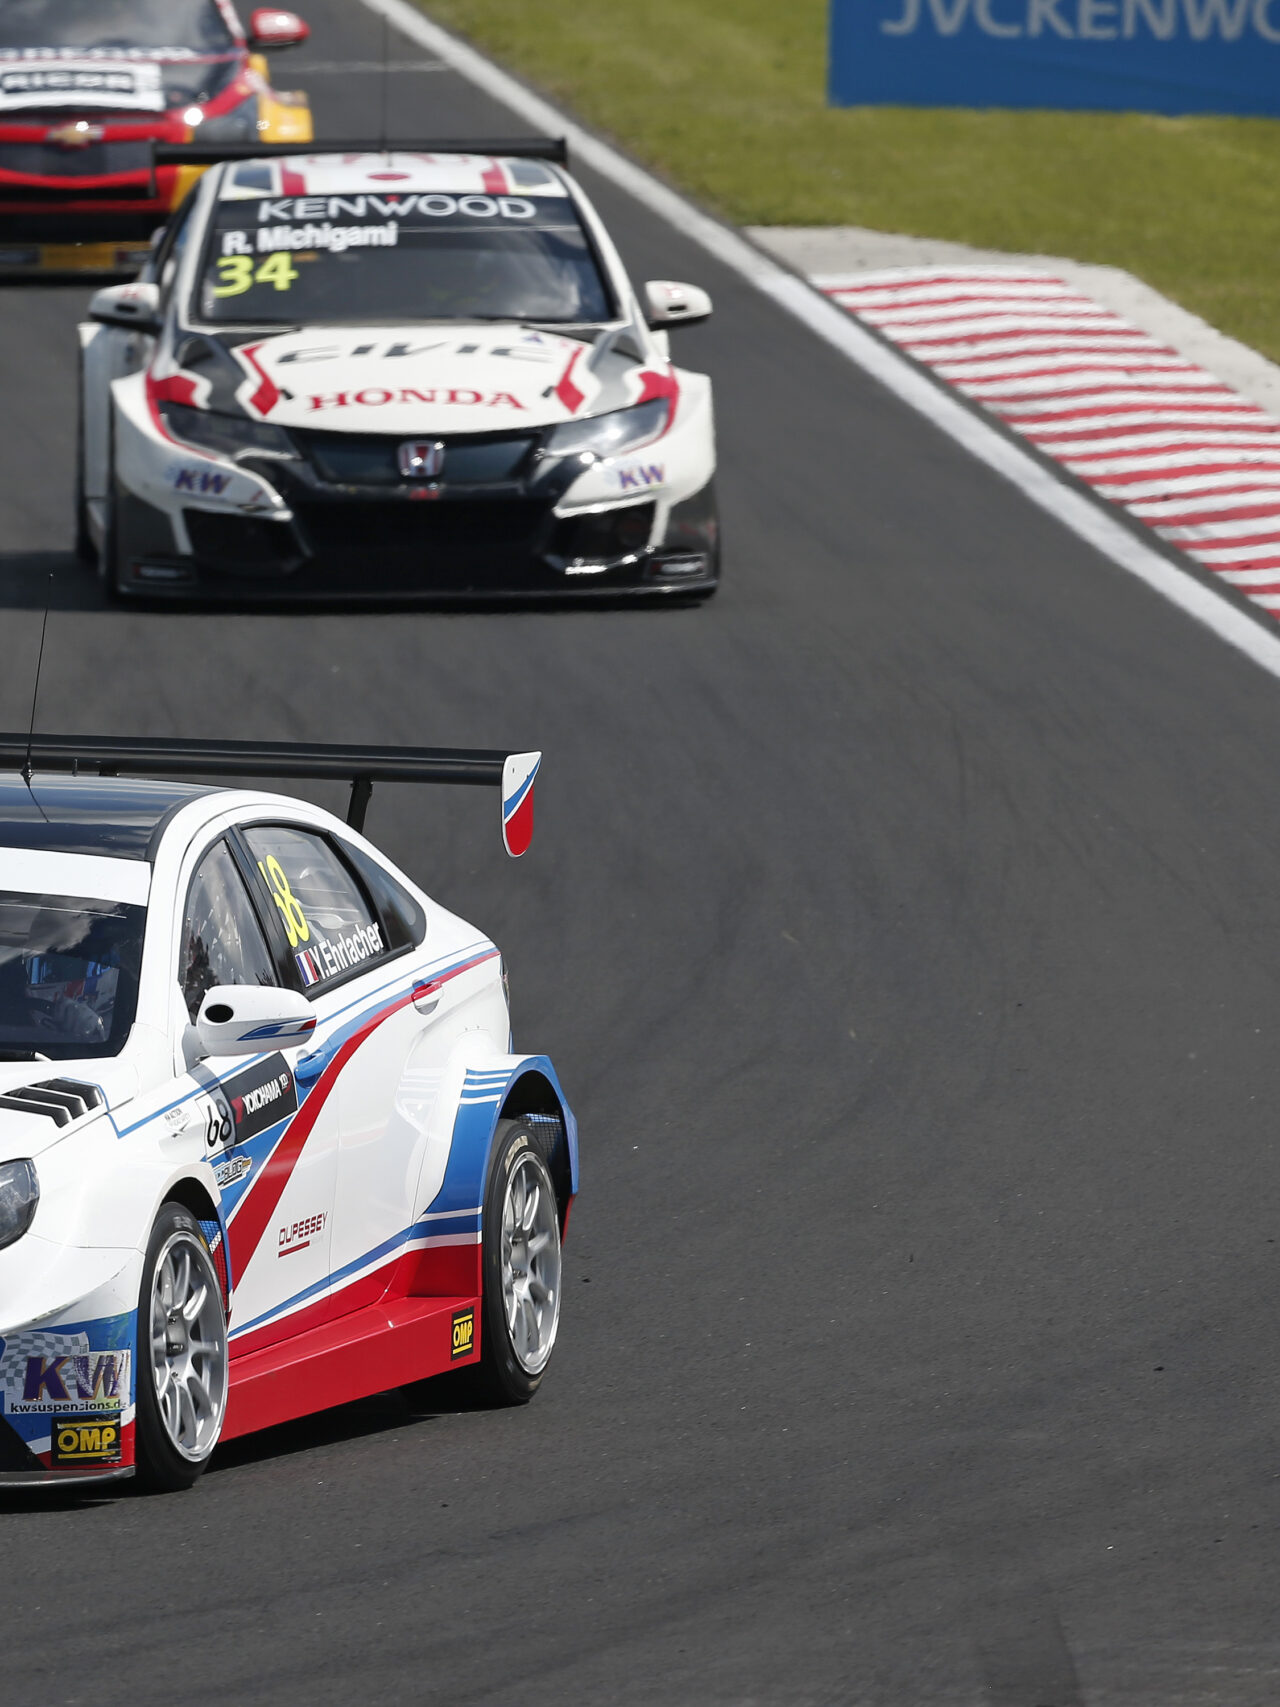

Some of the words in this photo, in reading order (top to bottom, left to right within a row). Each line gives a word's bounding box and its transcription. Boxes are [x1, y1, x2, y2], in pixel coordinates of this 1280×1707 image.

[258, 195, 536, 223] KENWOOD
[222, 231, 253, 255] R.
[256, 221, 398, 251] Michigami
[213, 251, 300, 298] 34
[277, 342, 553, 364] CIVIC
[306, 387, 532, 413] HONDA
[174, 468, 233, 496] KW
[620, 464, 666, 490] KW
[308, 921, 384, 980] Y.Ehrlacher
[242, 1079, 282, 1115] YOKOHAMA
[207, 1099, 232, 1147] 68
[453, 1321, 473, 1347] OMP
[23, 1354, 129, 1402] KW
[58, 1427, 116, 1452] OMP
